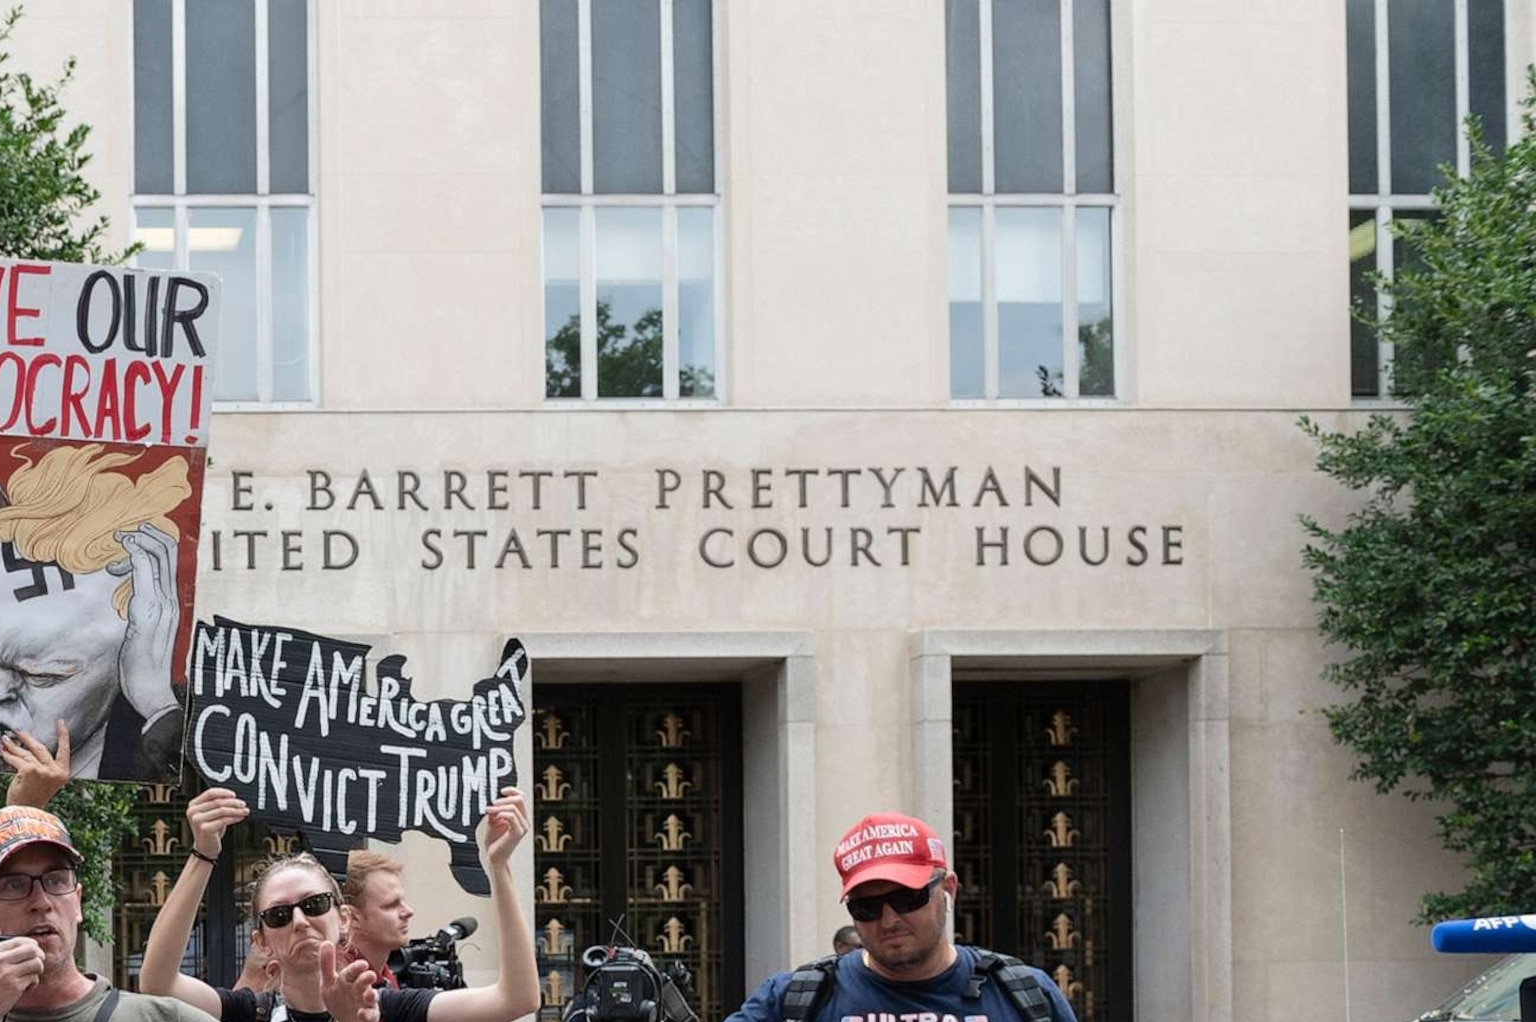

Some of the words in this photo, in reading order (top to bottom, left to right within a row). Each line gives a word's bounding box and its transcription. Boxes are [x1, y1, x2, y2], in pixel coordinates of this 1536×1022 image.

[76, 270, 210, 358] OUR
[231, 468, 275, 512] E.
[305, 467, 599, 512] BARRETT
[654, 464, 1064, 511] PRETTYMAN
[420, 526, 640, 572] STATES
[698, 525, 922, 570] COURT
[975, 523, 1185, 569] HOUSE
[193, 626, 294, 709] MAKE
[450, 648, 525, 750] GREAT
[193, 704, 387, 835] CONVICT
[380, 744, 514, 843] TRUMP
[842, 844, 873, 871] GREAT
[874, 840, 914, 858] AGAIN
[862, 823, 919, 842] AMERICA
[1473, 917, 1520, 930] AFP
